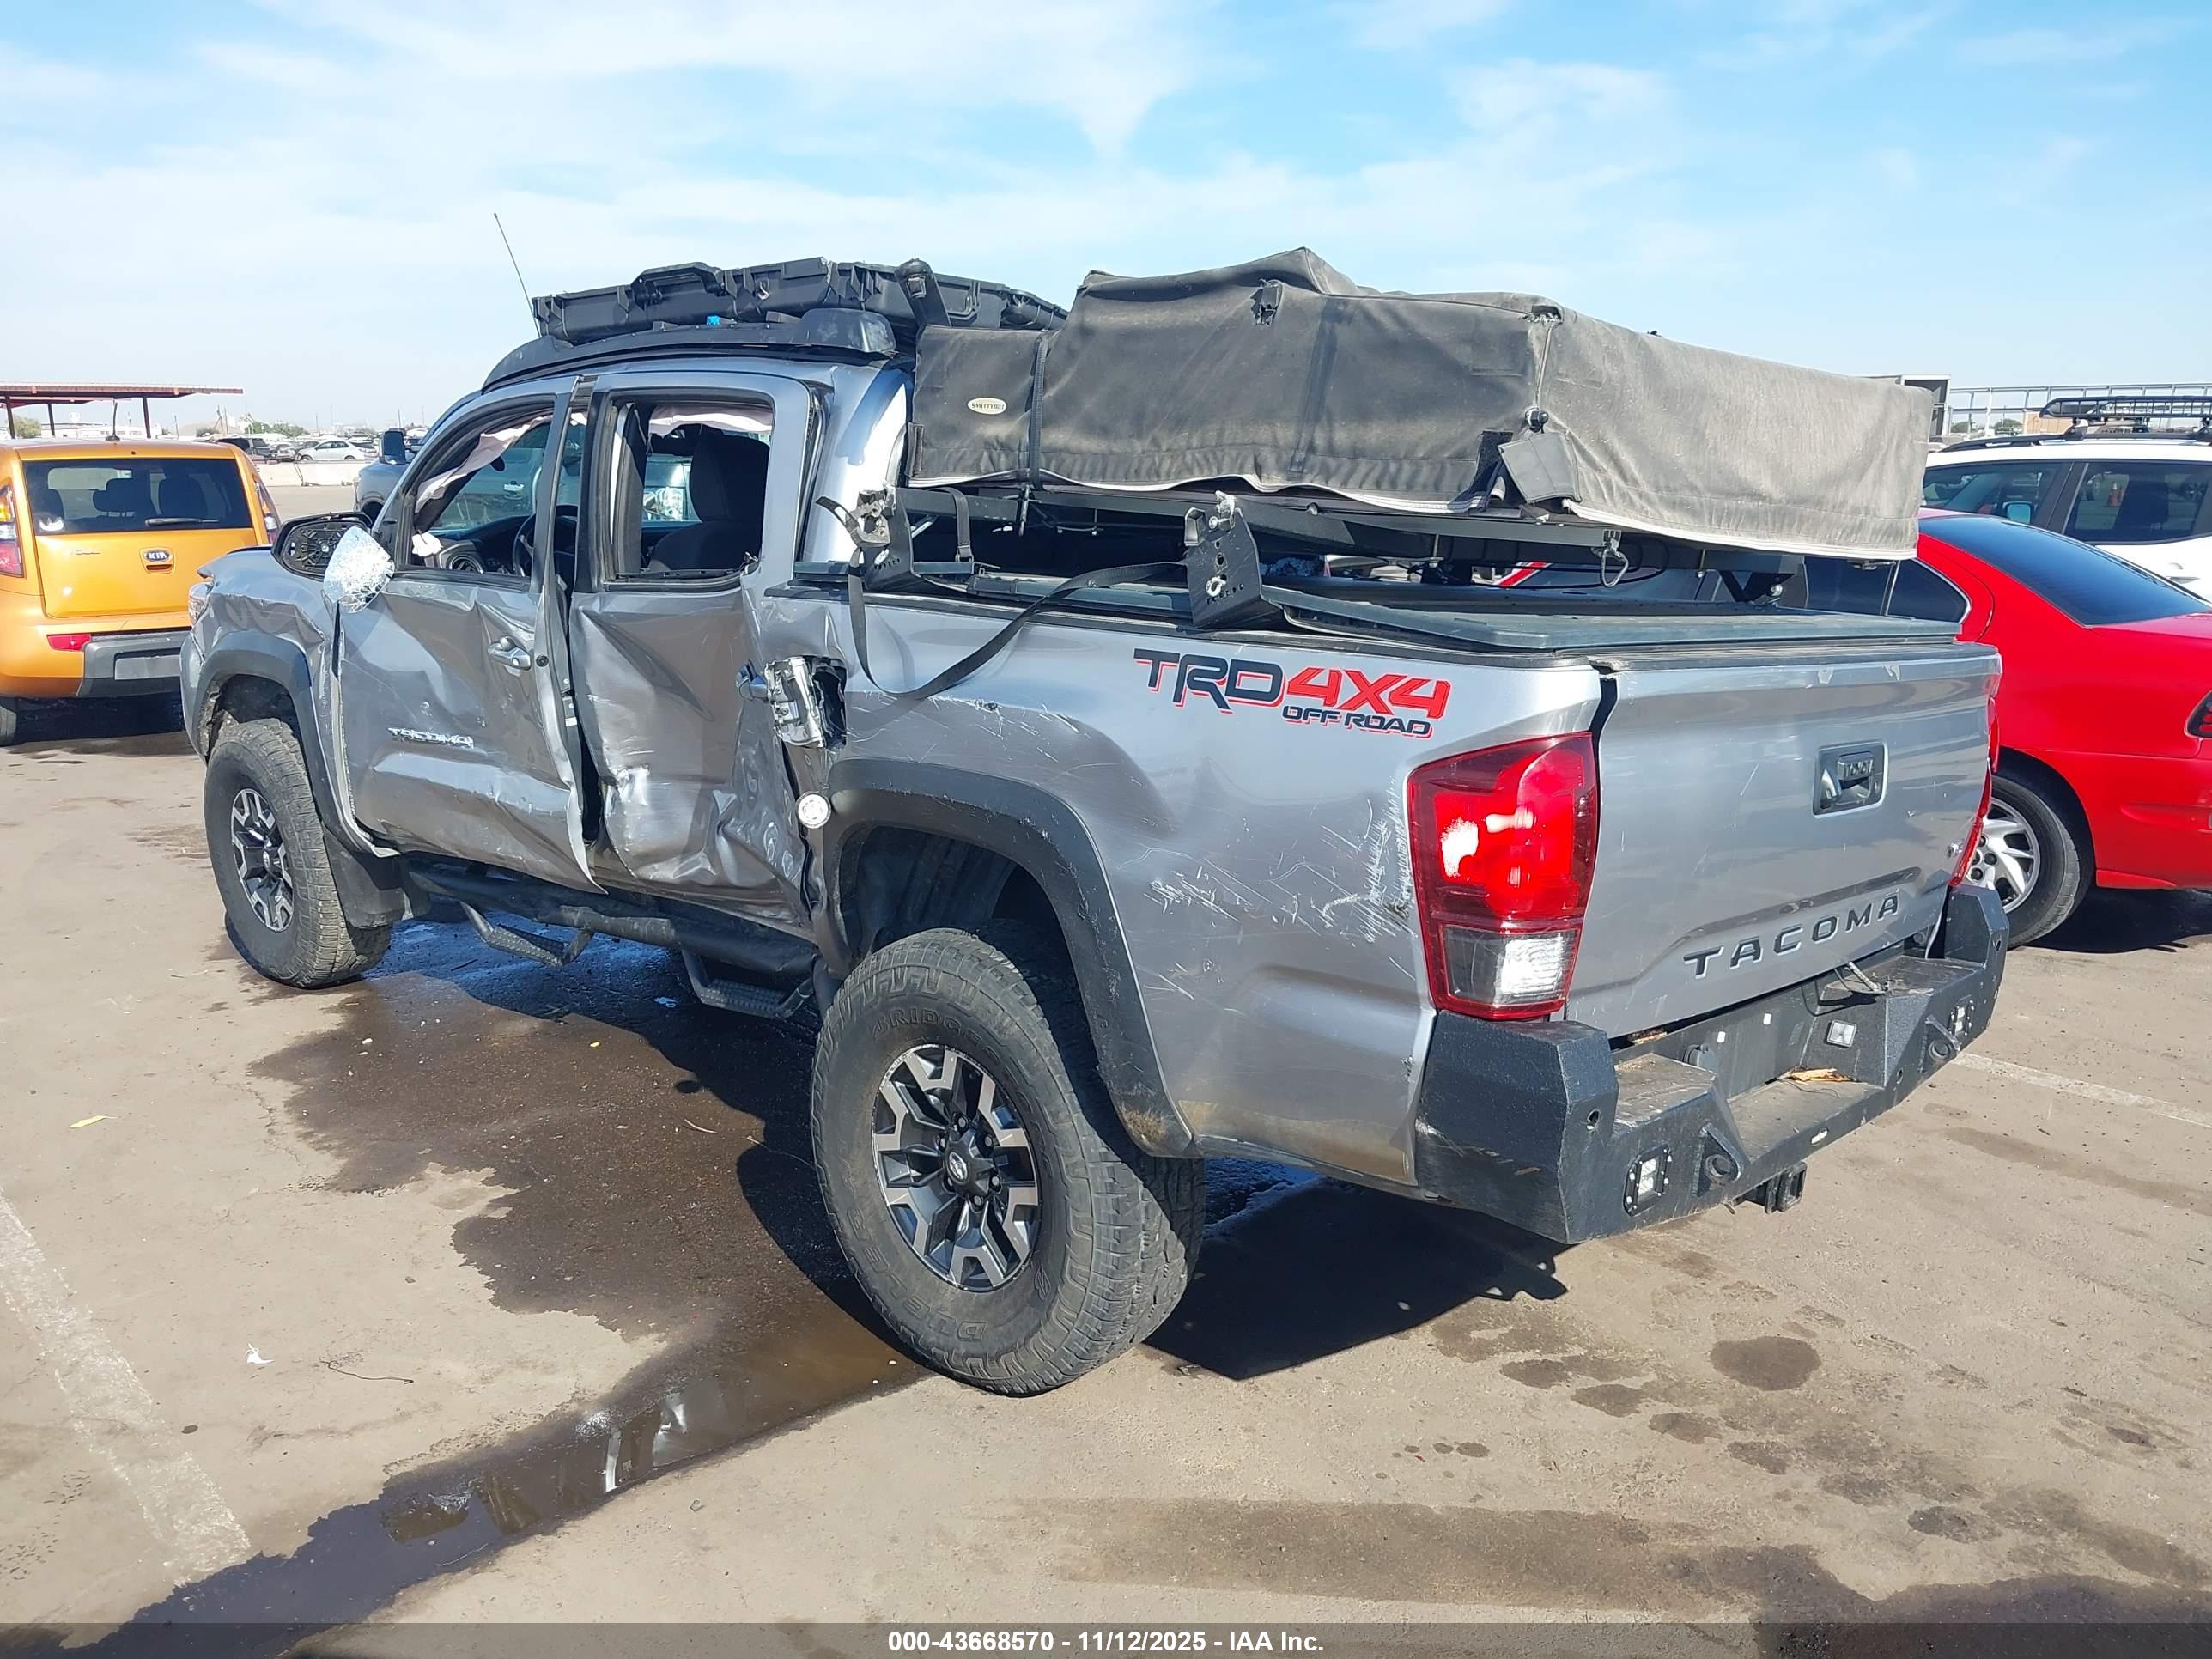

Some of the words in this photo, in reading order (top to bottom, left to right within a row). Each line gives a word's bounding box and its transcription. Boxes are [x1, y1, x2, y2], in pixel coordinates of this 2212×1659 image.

[147, 551, 169, 561] KIA
[1133, 648, 1286, 714] TRD
[1281, 705, 1344, 728] OFF
[1343, 712, 1433, 738] ROAD
[1683, 890, 1900, 980] TACOMA
